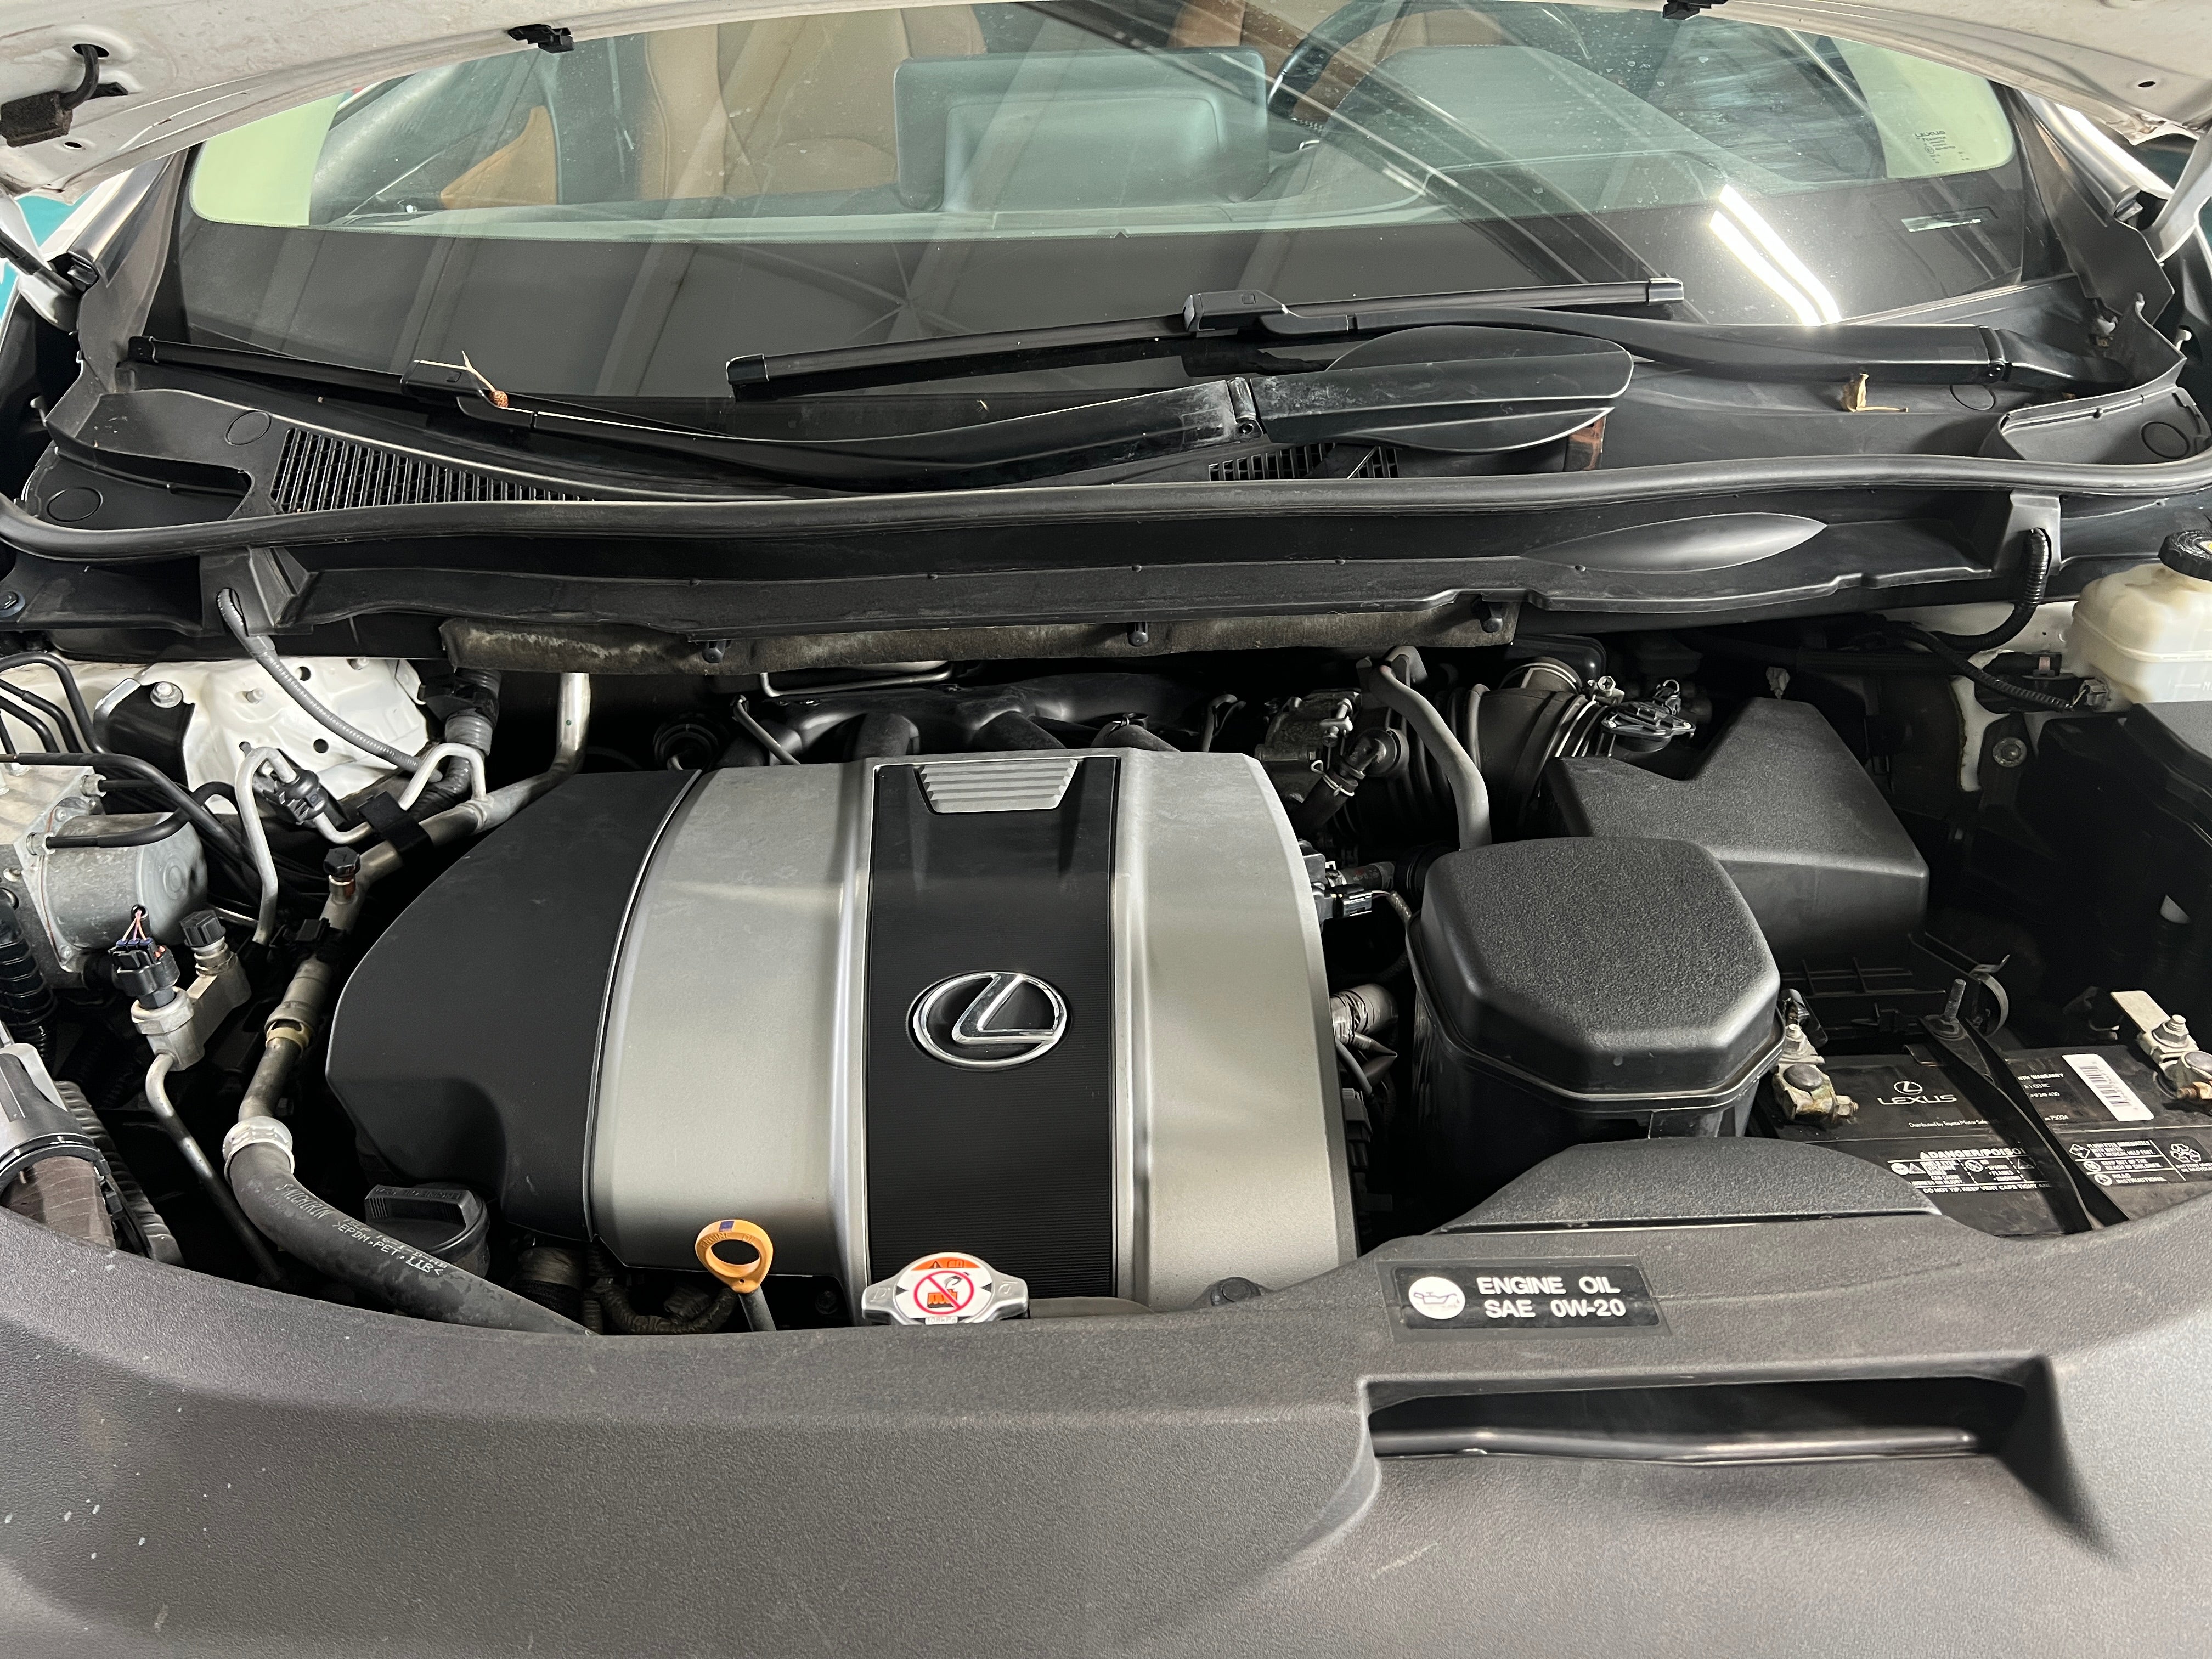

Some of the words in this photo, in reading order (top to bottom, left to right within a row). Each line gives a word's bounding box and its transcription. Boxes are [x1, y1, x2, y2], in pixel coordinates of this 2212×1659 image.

[1877, 1094, 1957, 1105] LEXUS
[1476, 1276, 1567, 1295] ENGINE
[1578, 1276, 1621, 1295] OIL
[1483, 1299, 1536, 1318] SAE
[1550, 1299, 1627, 1318] 0W-20
